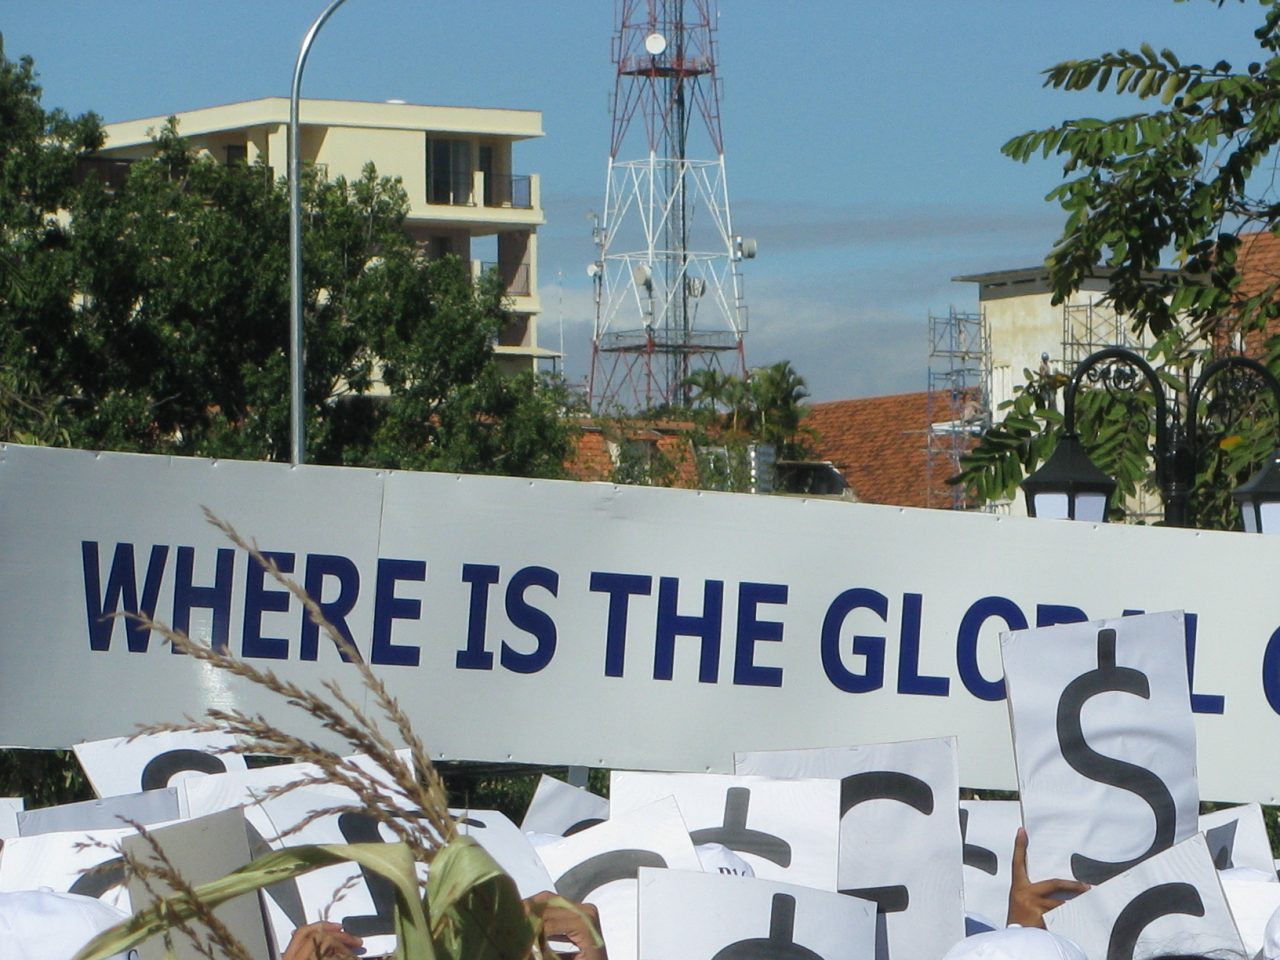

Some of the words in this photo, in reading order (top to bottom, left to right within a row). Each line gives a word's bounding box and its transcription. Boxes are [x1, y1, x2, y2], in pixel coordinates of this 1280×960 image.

[81, 540, 426, 667] WHERE
[456, 563, 560, 675] IS
[590, 571, 789, 688] THE
[822, 587, 1225, 715] GLOL
